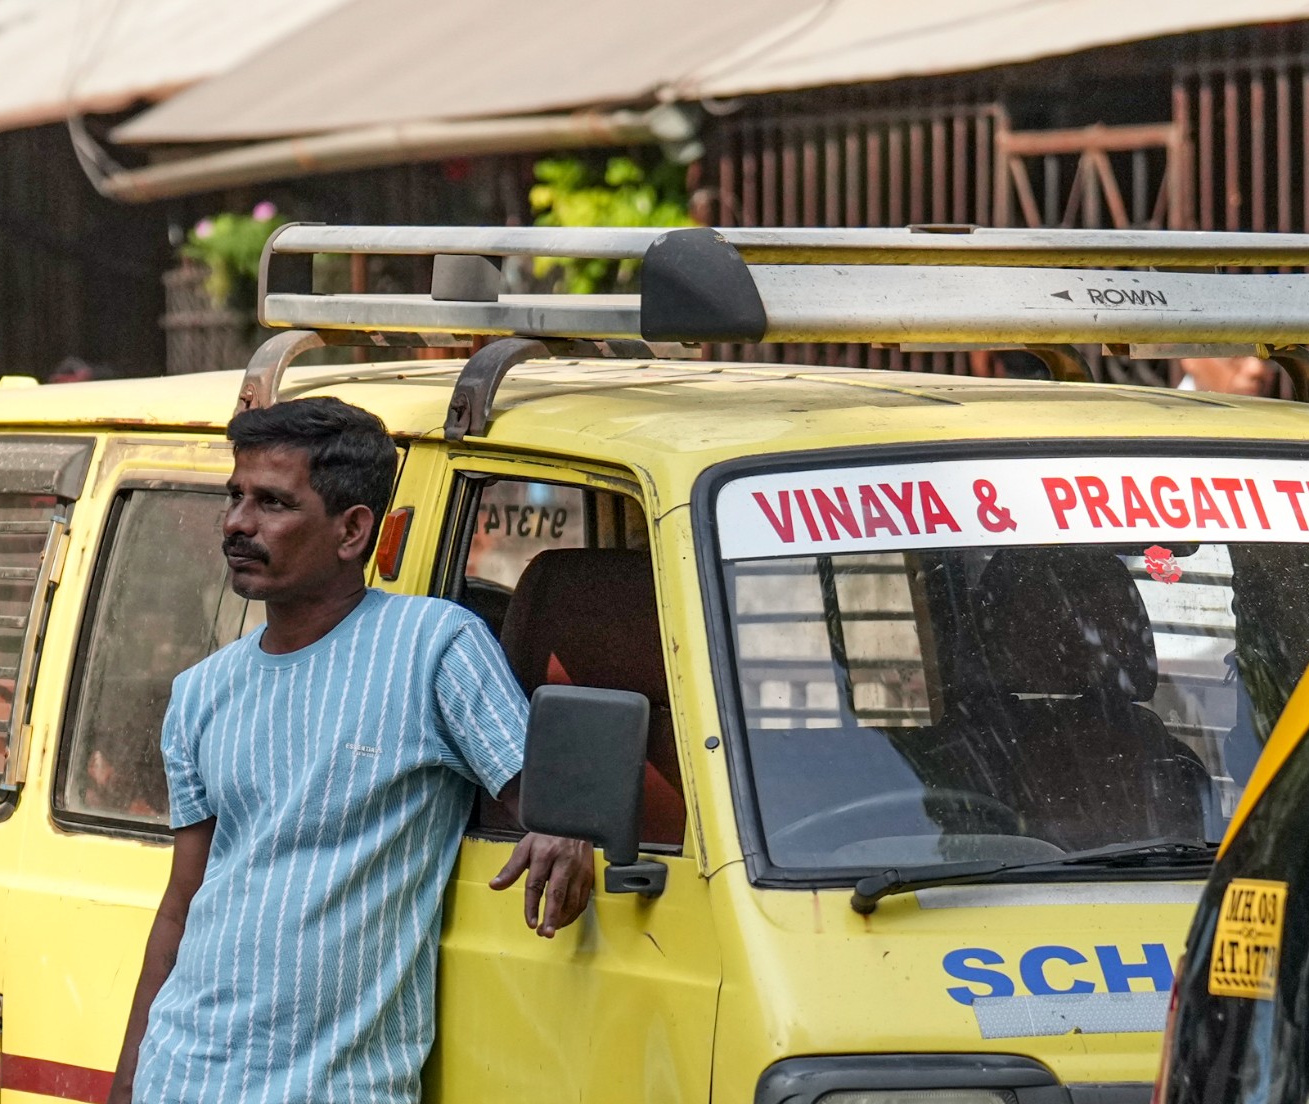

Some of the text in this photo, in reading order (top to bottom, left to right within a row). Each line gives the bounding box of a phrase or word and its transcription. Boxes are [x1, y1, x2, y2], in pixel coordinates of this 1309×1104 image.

[1086, 288, 1168, 306] ROWN
[751, 480, 962, 543] VINAYA
[972, 478, 1018, 533] &
[1041, 475, 1271, 530] PRAGATI
[942, 943, 1175, 1007] SCH
